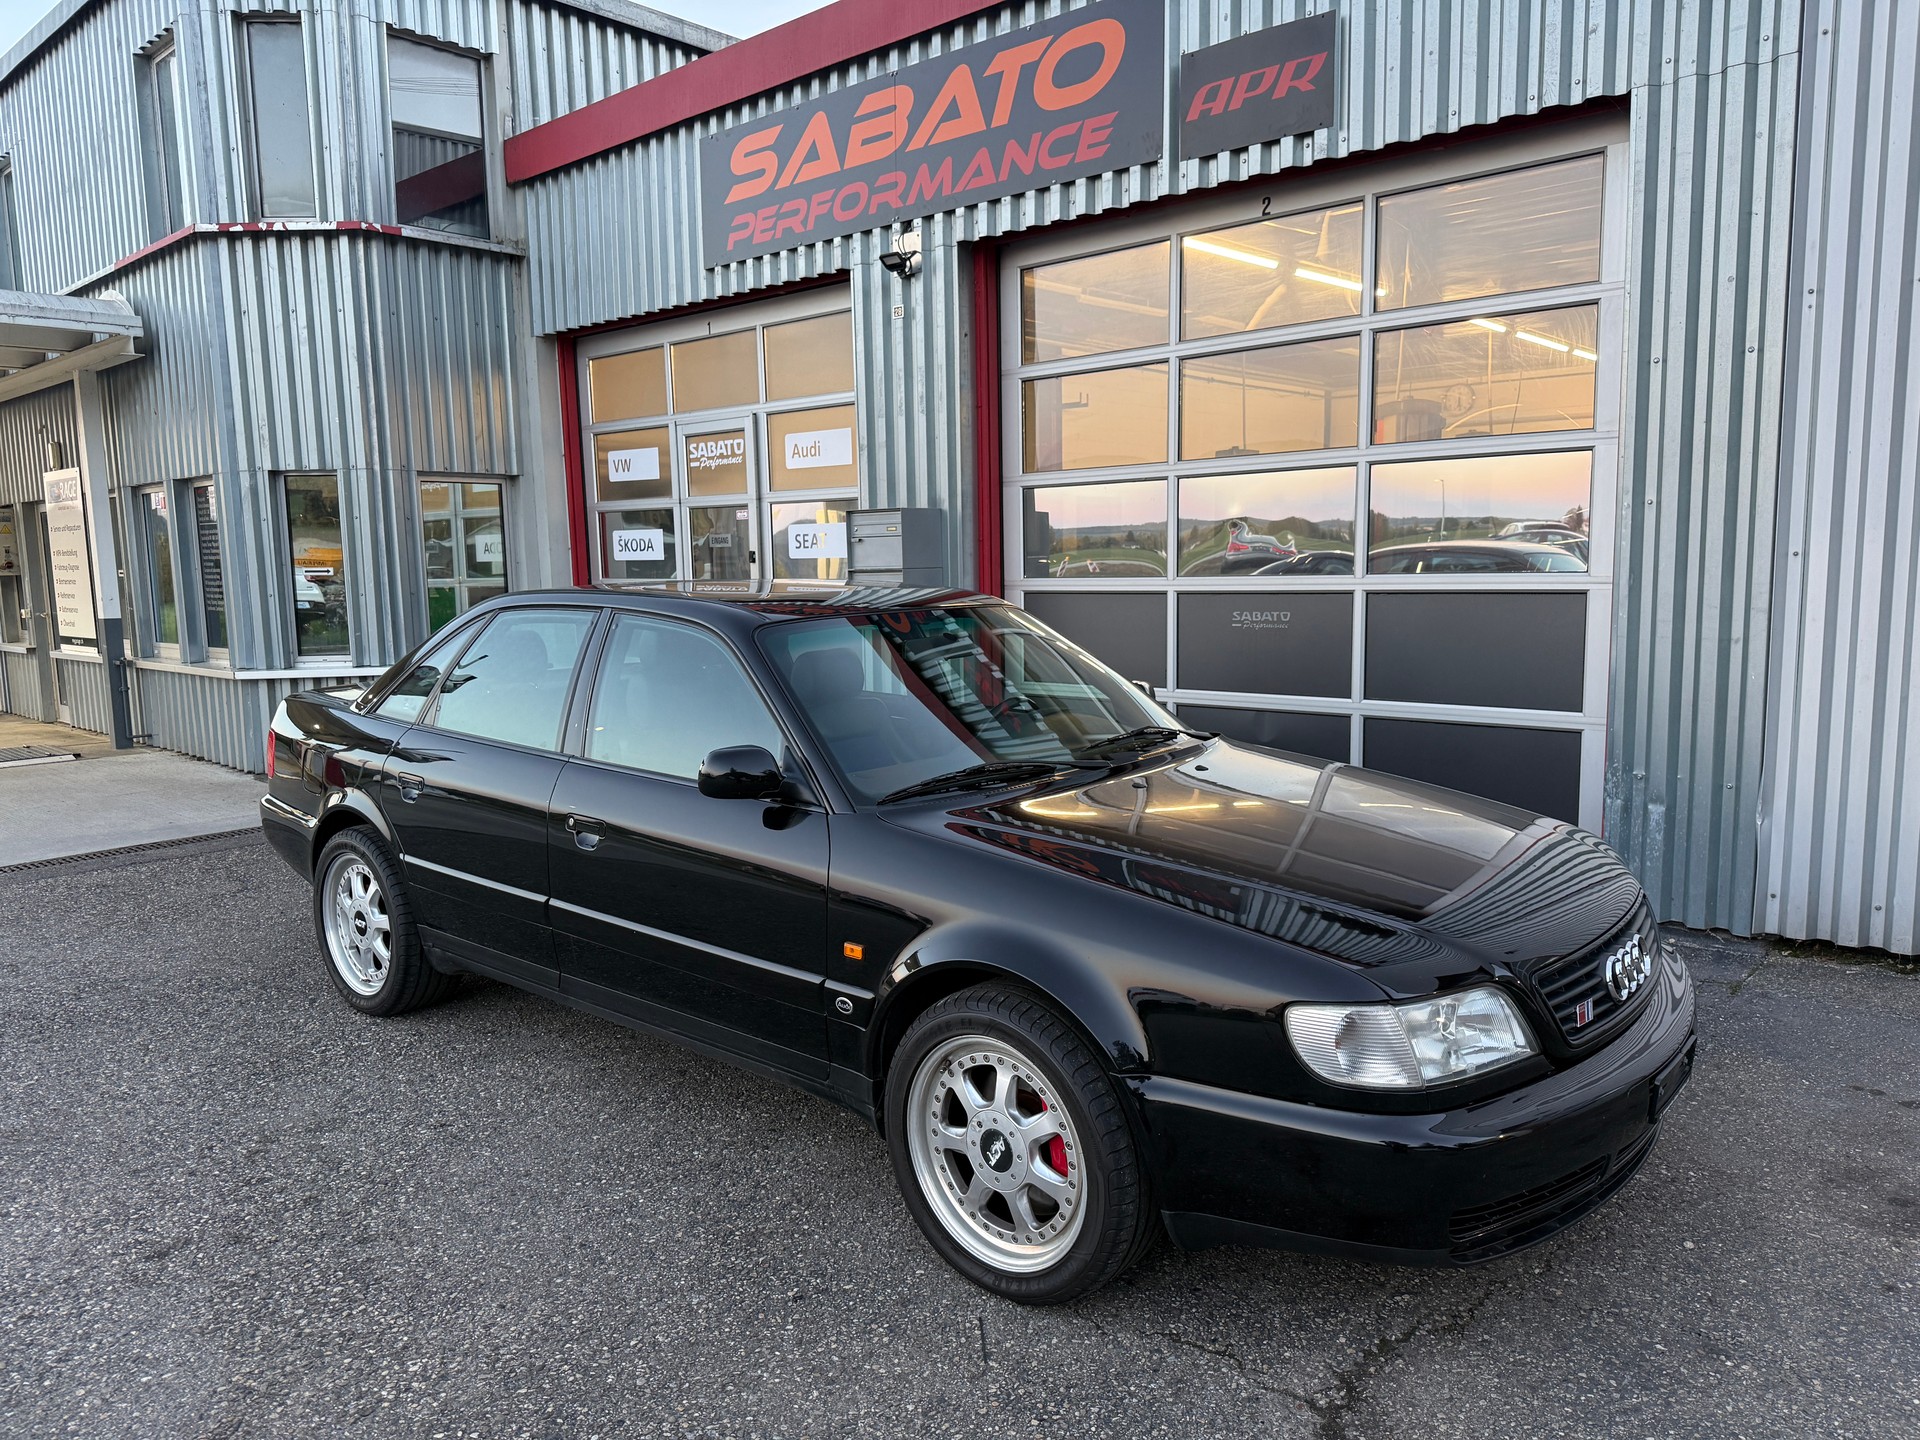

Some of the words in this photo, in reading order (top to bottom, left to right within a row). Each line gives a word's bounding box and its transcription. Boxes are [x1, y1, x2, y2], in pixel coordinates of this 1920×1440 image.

[1185, 52, 1328, 122] APR
[724, 18, 1126, 204] SABATO
[726, 111, 1119, 251] PERFORMANCE
[1262, 196, 1271, 216] 2
[689, 439, 744, 459] SABATO
[791, 440, 821, 459] Audi
[613, 458, 631, 473] VW
[700, 456, 743, 470] Performance
[618, 535, 655, 552] ŠKODA
[711, 536, 729, 545] EINGANG
[794, 532, 827, 549] SEAT
[1232, 611, 1291, 621] SABATO
